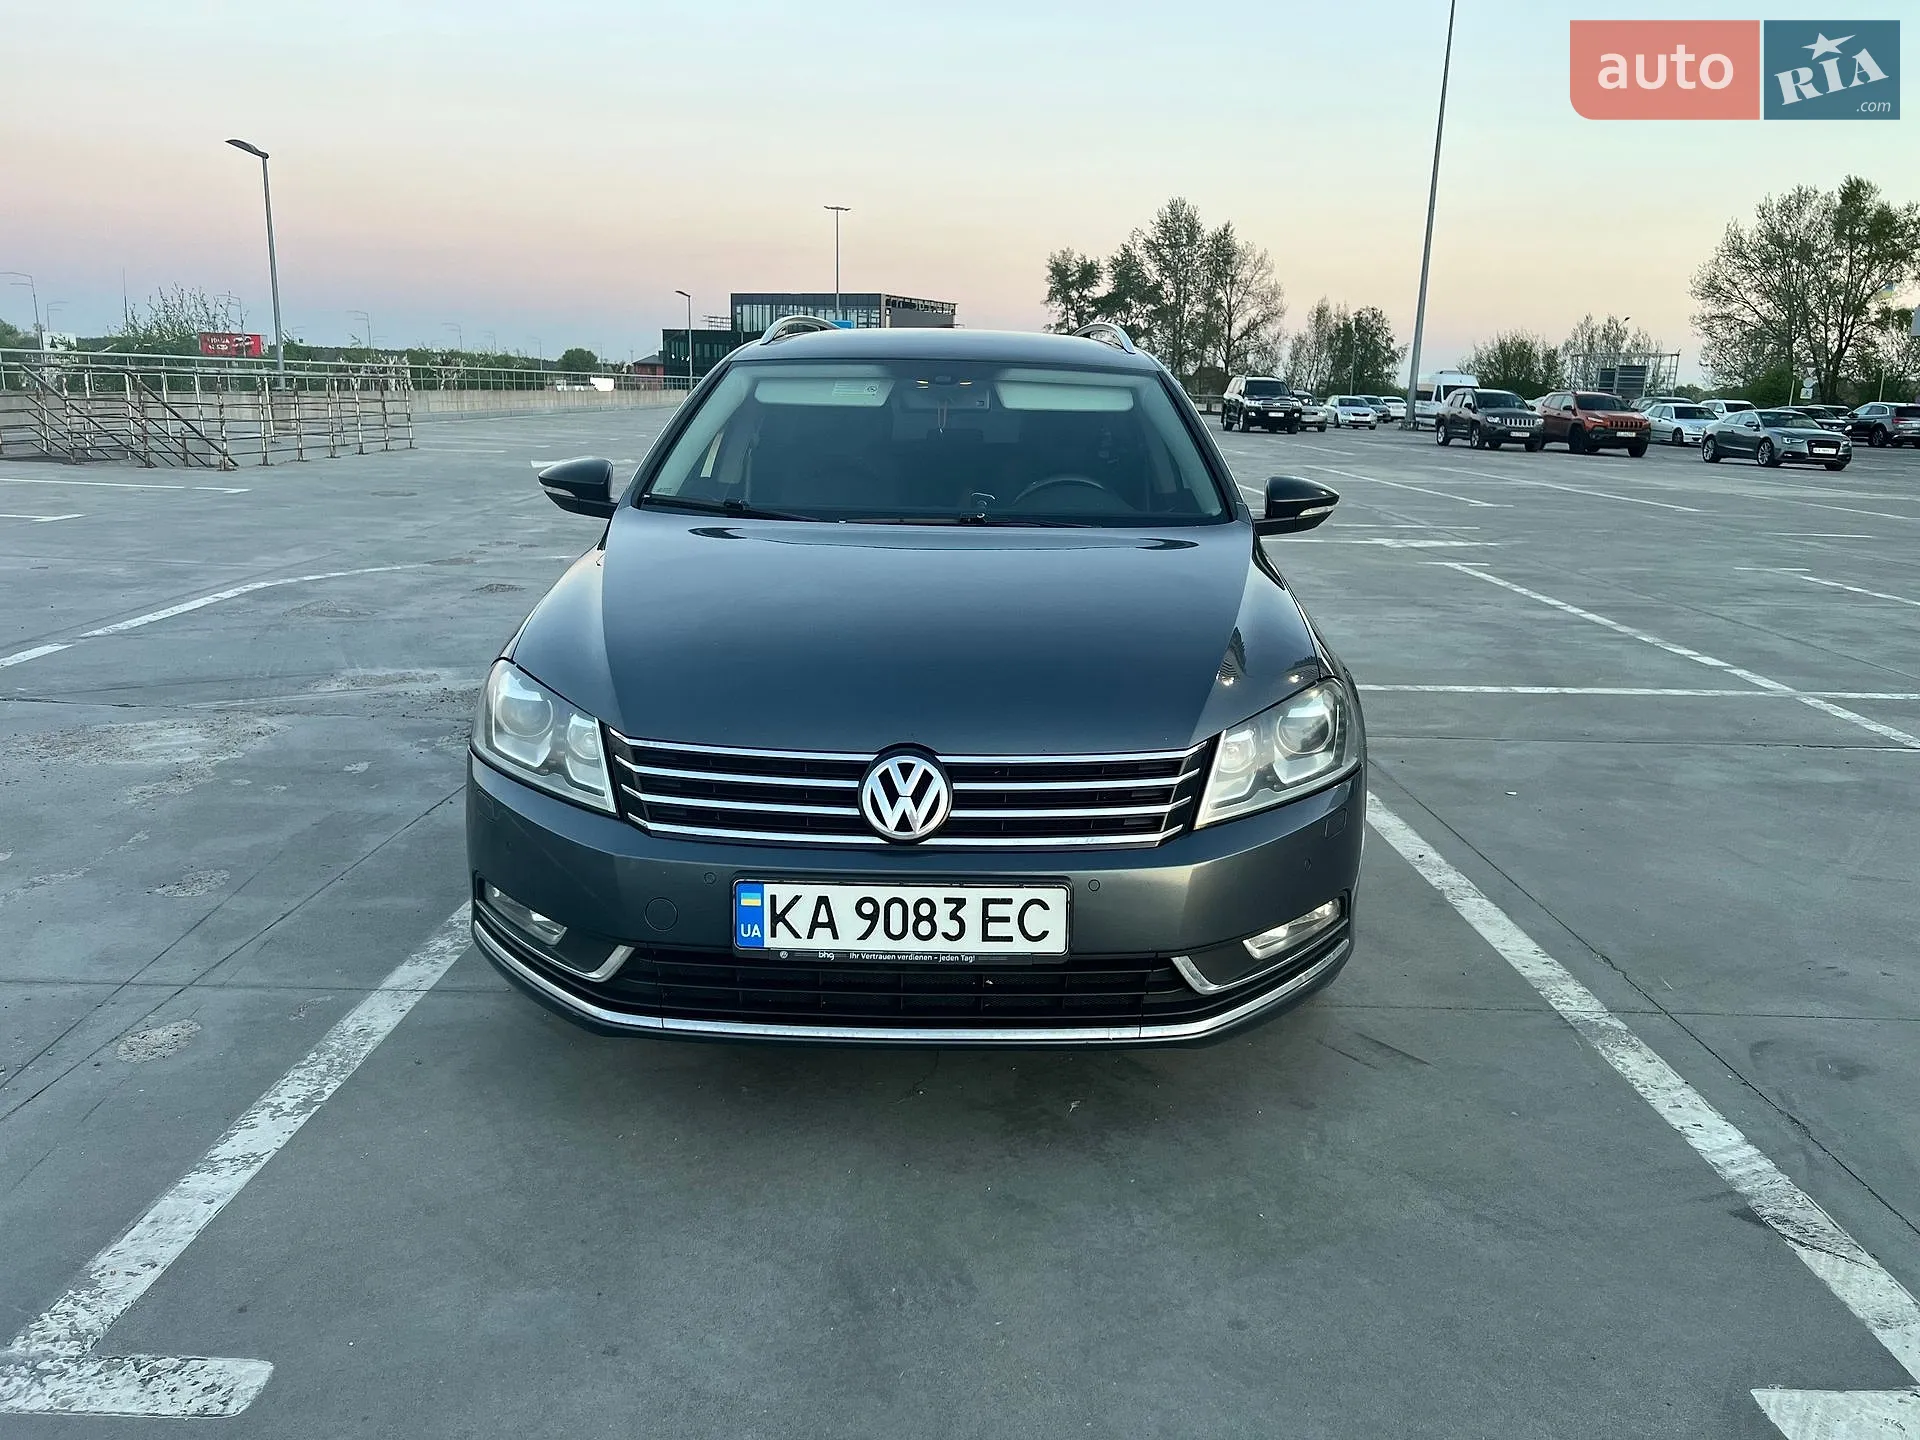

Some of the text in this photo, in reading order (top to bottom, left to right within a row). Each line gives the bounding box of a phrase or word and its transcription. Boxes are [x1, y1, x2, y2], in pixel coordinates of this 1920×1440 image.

[769, 894, 1050, 943] KA 9083 EC
[741, 923, 762, 938] UA
[818, 951, 835, 961] bhg
[849, 952, 860, 960] Ihr
[861, 952, 896, 961] Vertrauen
[896, 953, 933, 962] verdienen
[938, 954, 960, 963] jeden
[960, 954, 976, 963] Tag!
